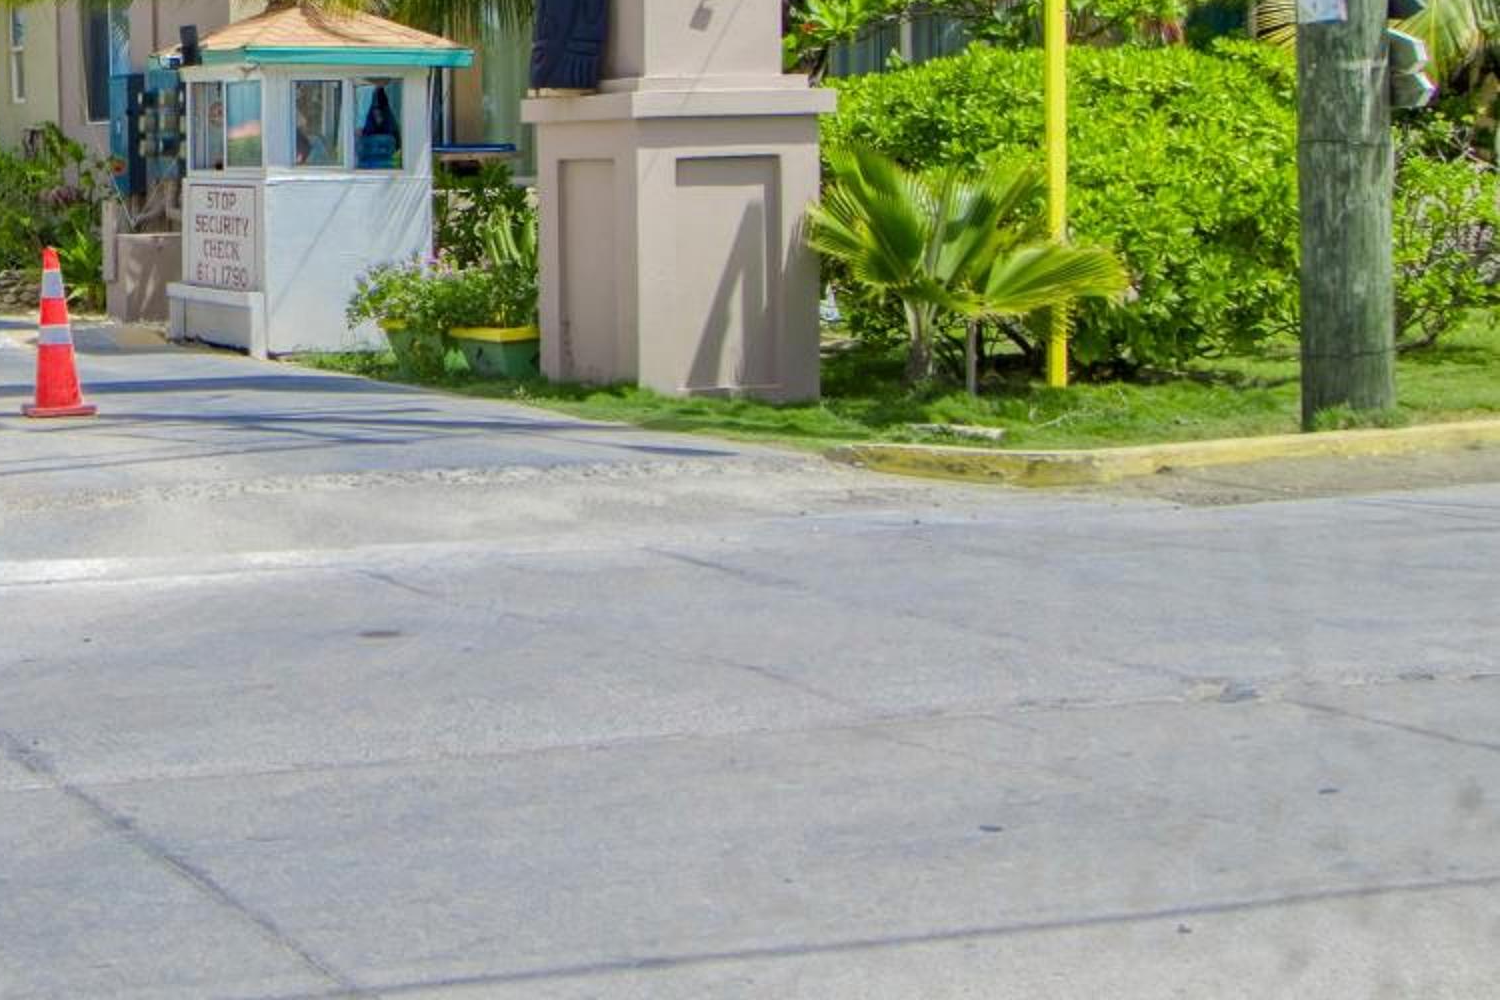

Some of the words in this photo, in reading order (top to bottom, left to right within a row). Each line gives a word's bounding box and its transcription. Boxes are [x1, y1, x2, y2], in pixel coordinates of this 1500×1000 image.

[207, 192, 237, 210] STOP
[196, 215, 250, 238] SECURITY
[204, 240, 240, 261] CHECK
